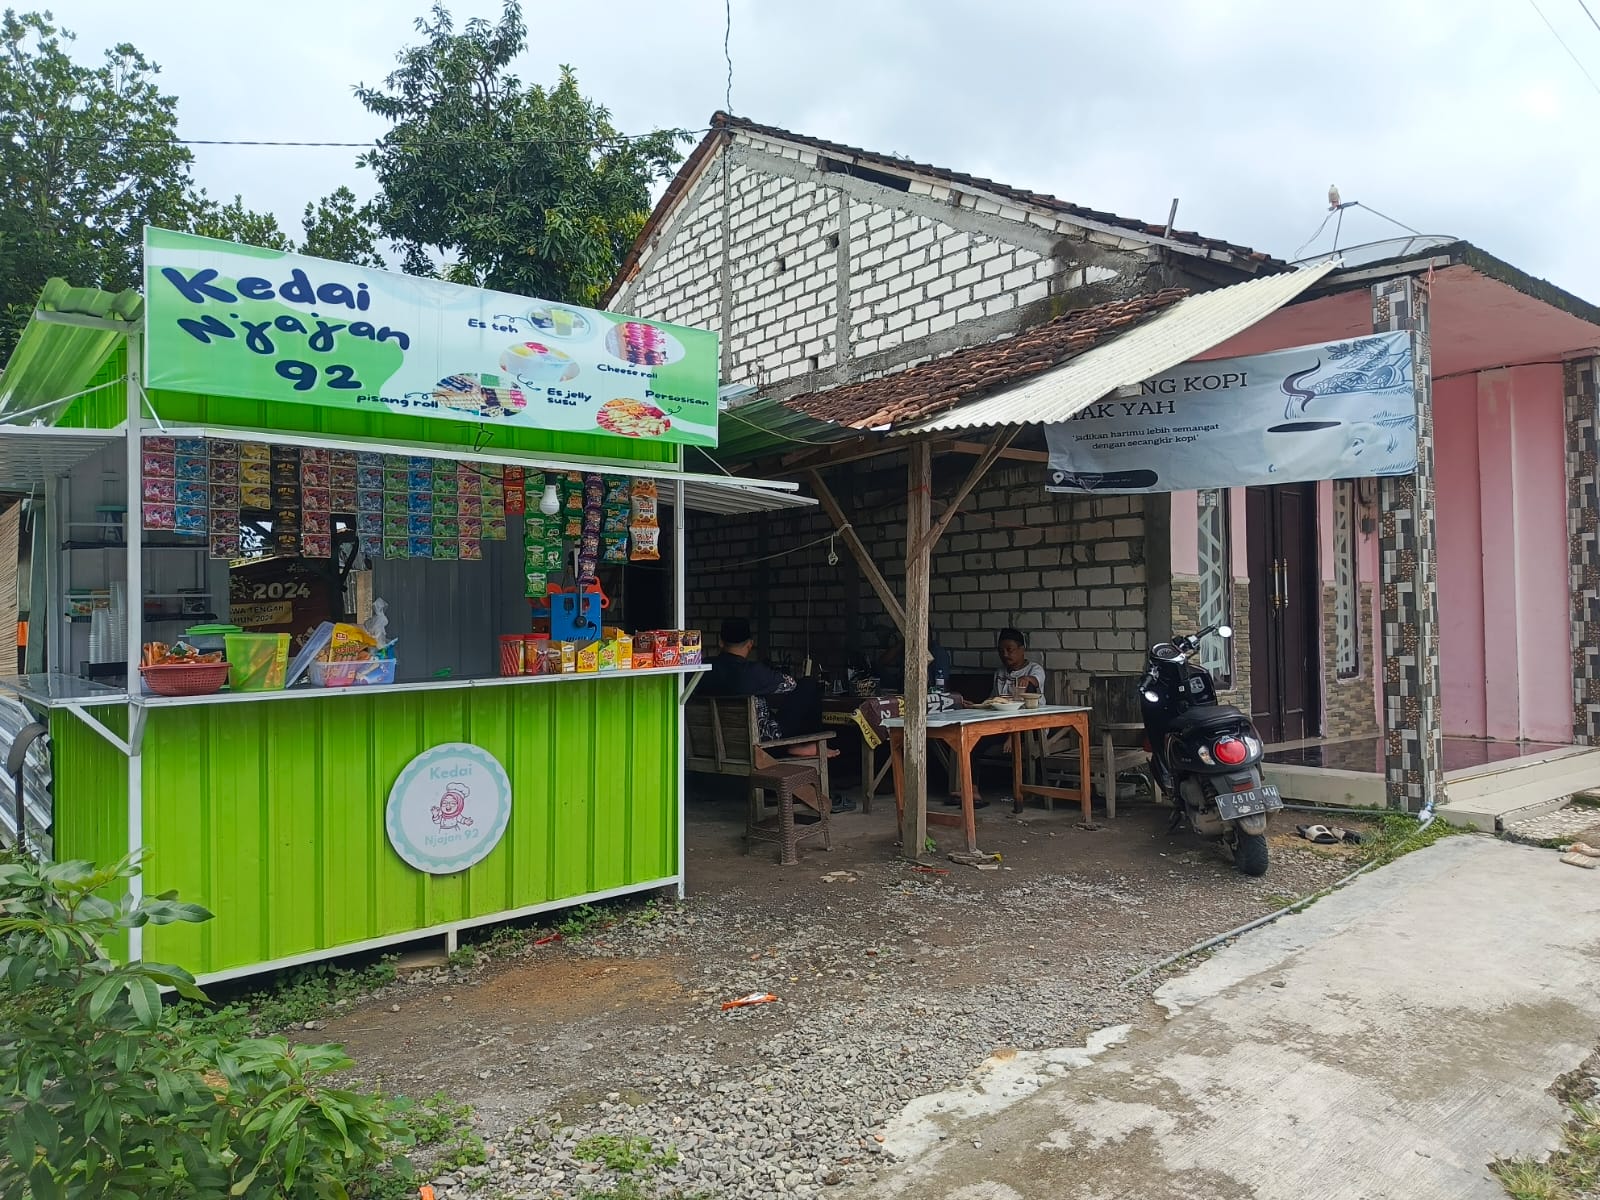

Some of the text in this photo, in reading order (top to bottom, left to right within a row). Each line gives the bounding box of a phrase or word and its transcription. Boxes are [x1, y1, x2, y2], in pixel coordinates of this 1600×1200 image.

[161, 267, 371, 311] Kedai
[468, 318, 518, 333] Es teh
[177, 312, 410, 355] Njajan
[275, 360, 362, 391] 92
[597, 364, 638, 376] Cheese
[1183, 372, 1248, 392] KOPI
[357, 394, 439, 408] pisang roll
[547, 387, 592, 402] Es jelly
[547, 397, 577, 406] susu
[1120, 401, 1176, 416] YAH
[1110, 430, 1145, 438] harimu
[1147, 426, 1171, 435] lebih
[1172, 423, 1220, 432] semangat
[1092, 441, 1126, 450] dengan
[1127, 436, 1173, 447] secangkir
[253, 582, 311, 600] 2024
[430, 763, 472, 780] Kedai
[1218, 797, 1226, 808] K
[424, 828, 479, 847] Njajan 92
